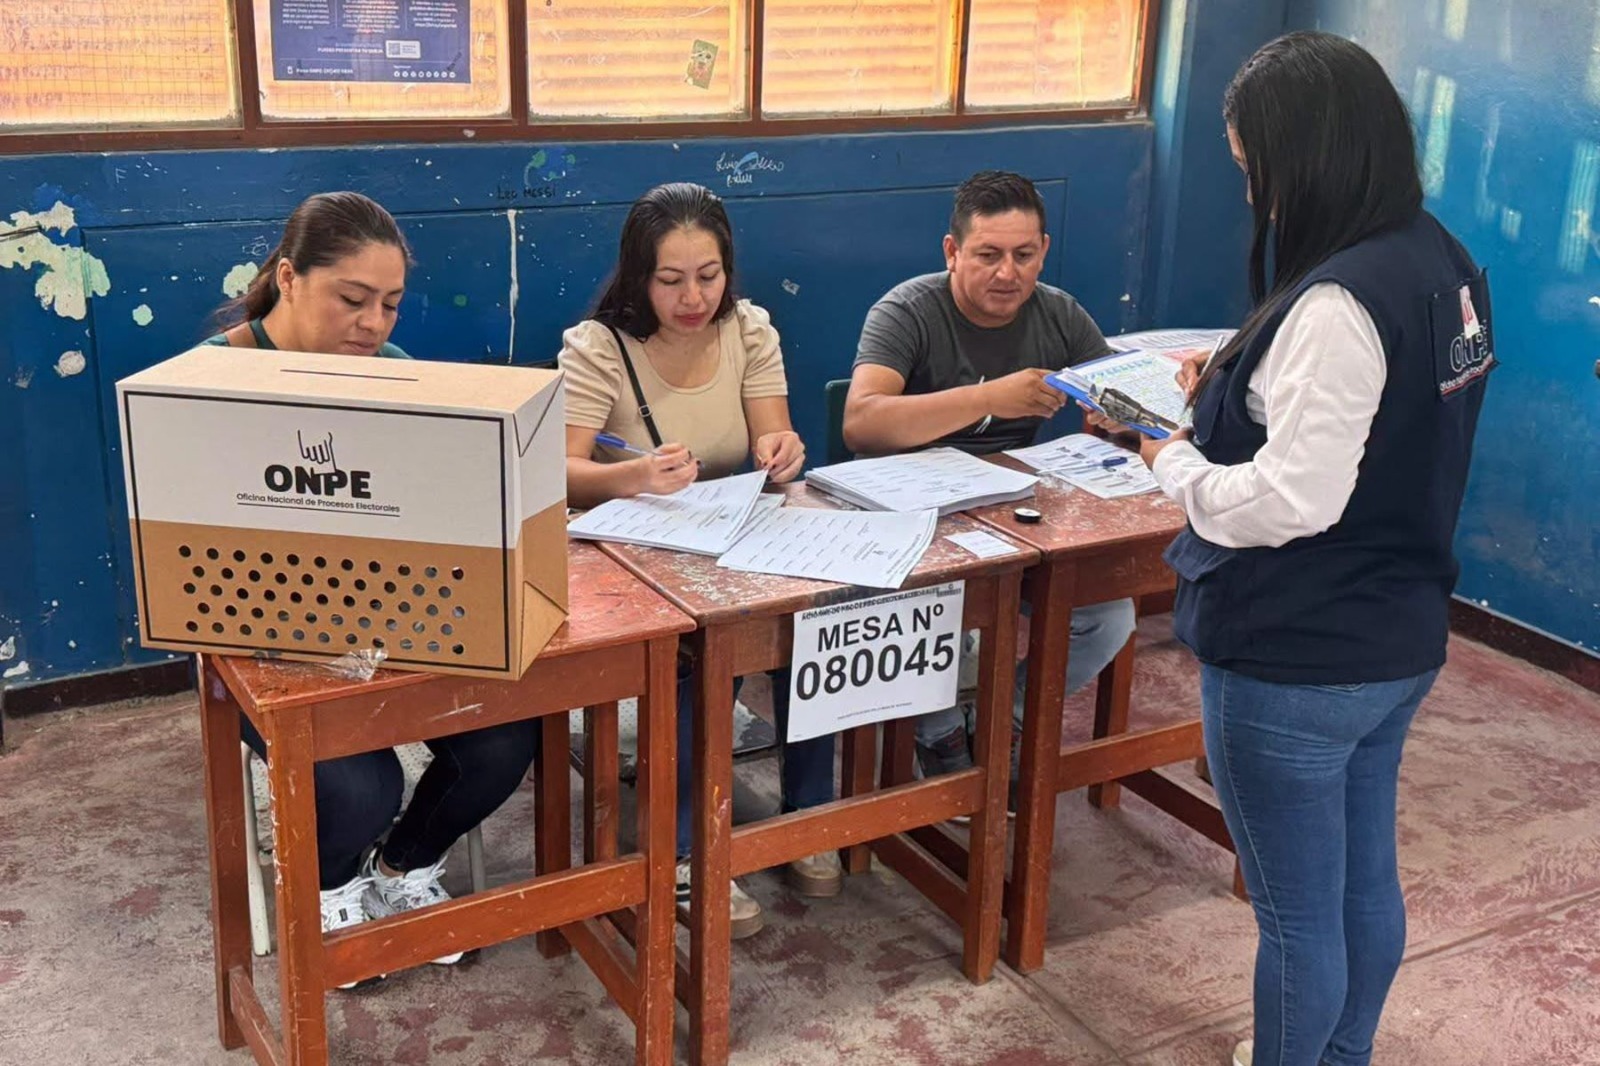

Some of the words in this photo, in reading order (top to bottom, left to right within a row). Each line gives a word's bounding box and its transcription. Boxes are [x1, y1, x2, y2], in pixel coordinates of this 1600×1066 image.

[264, 464, 371, 499] ONPE
[236, 493, 266, 502] Oficina
[267, 495, 304, 505] Nacional
[306, 498, 316, 506] de
[317, 499, 354, 510] Procesos
[356, 502, 400, 513] Electorales
[818, 612, 903, 652] MESA
[796, 632, 954, 701] 080045
